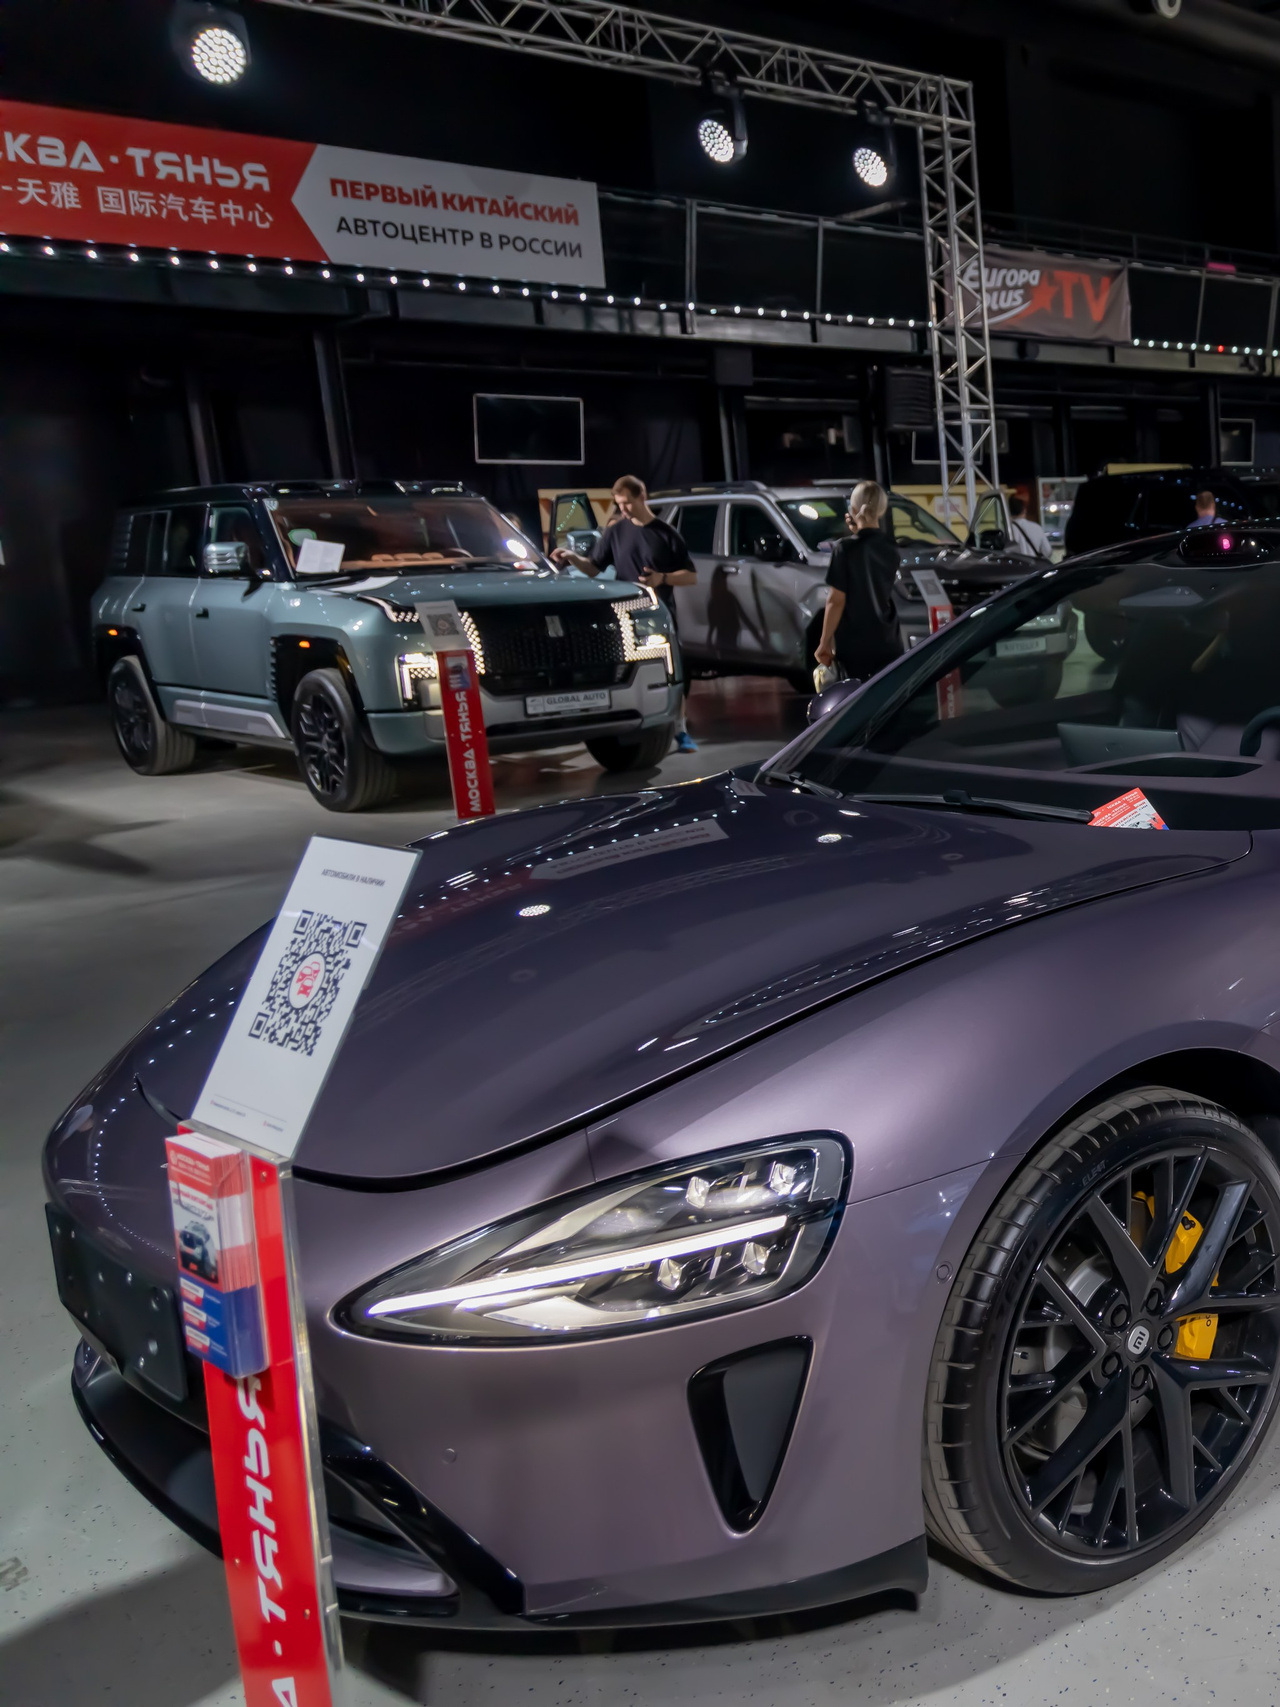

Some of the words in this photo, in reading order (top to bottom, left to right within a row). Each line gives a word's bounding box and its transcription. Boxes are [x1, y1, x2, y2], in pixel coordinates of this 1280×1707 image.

[0, 131, 104, 172] КВА
[125, 147, 271, 192] ТЯНЬЯ
[97, 185, 274, 229] 国际汽车中心
[329, 178, 438, 209] ПЕРВЫЙ
[442, 191, 580, 226] КИТАЙСКИЙ
[336, 216, 474, 246] АВТОЦЕНТР
[480, 232, 493, 248] В
[499, 233, 583, 258] РОССИИ
[1053, 269, 1111, 322] TV
[455, 690, 473, 743] ТЯНЬЯ
[546, 695, 580, 705] GLOBAL
[583, 691, 607, 701] AUTO
[462, 747, 482, 813] МОСКВА
[237, 1376, 287, 1623] ТЯНЬЯ
